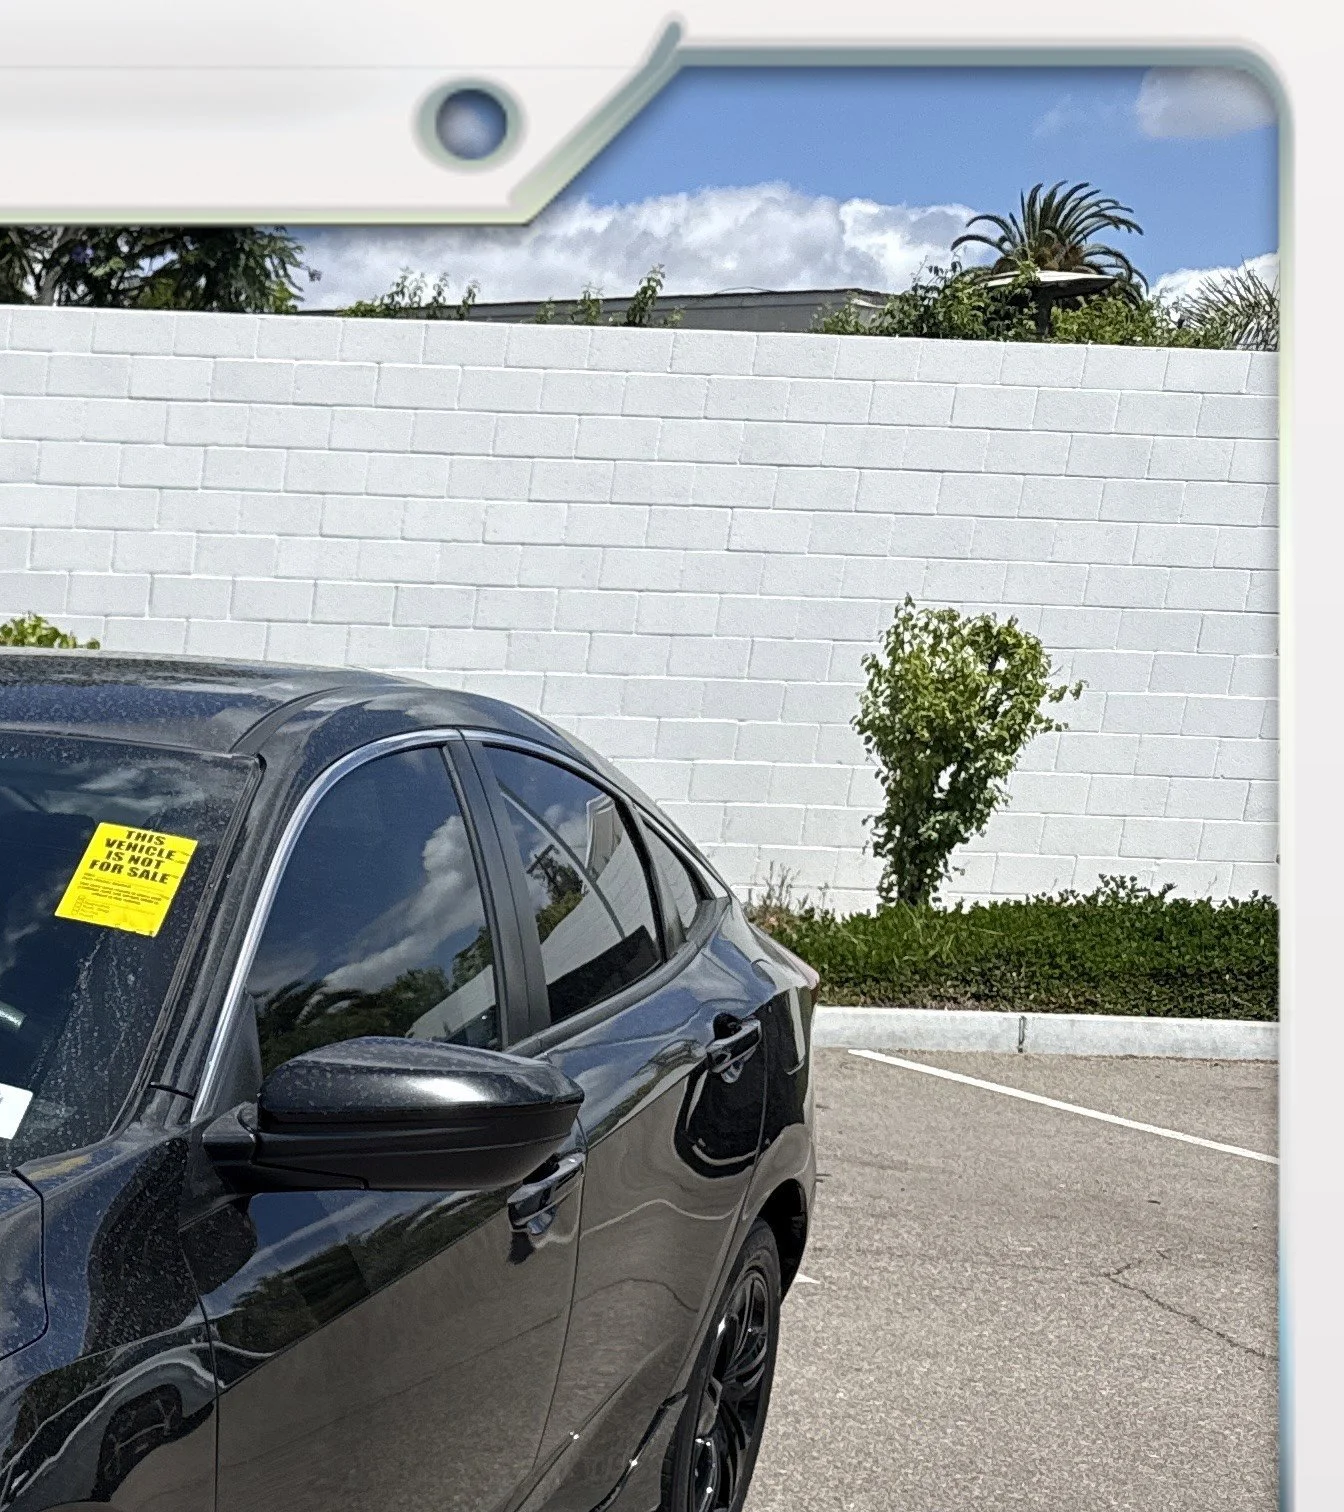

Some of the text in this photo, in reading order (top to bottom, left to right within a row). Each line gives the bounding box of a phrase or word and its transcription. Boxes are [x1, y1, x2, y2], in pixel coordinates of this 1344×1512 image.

[125, 830, 166, 846] THIS
[105, 838, 177, 861] VEHICLE
[105, 850, 165, 870] IS NOT
[89, 859, 124, 875] FOR
[127, 866, 171, 885] SALE
